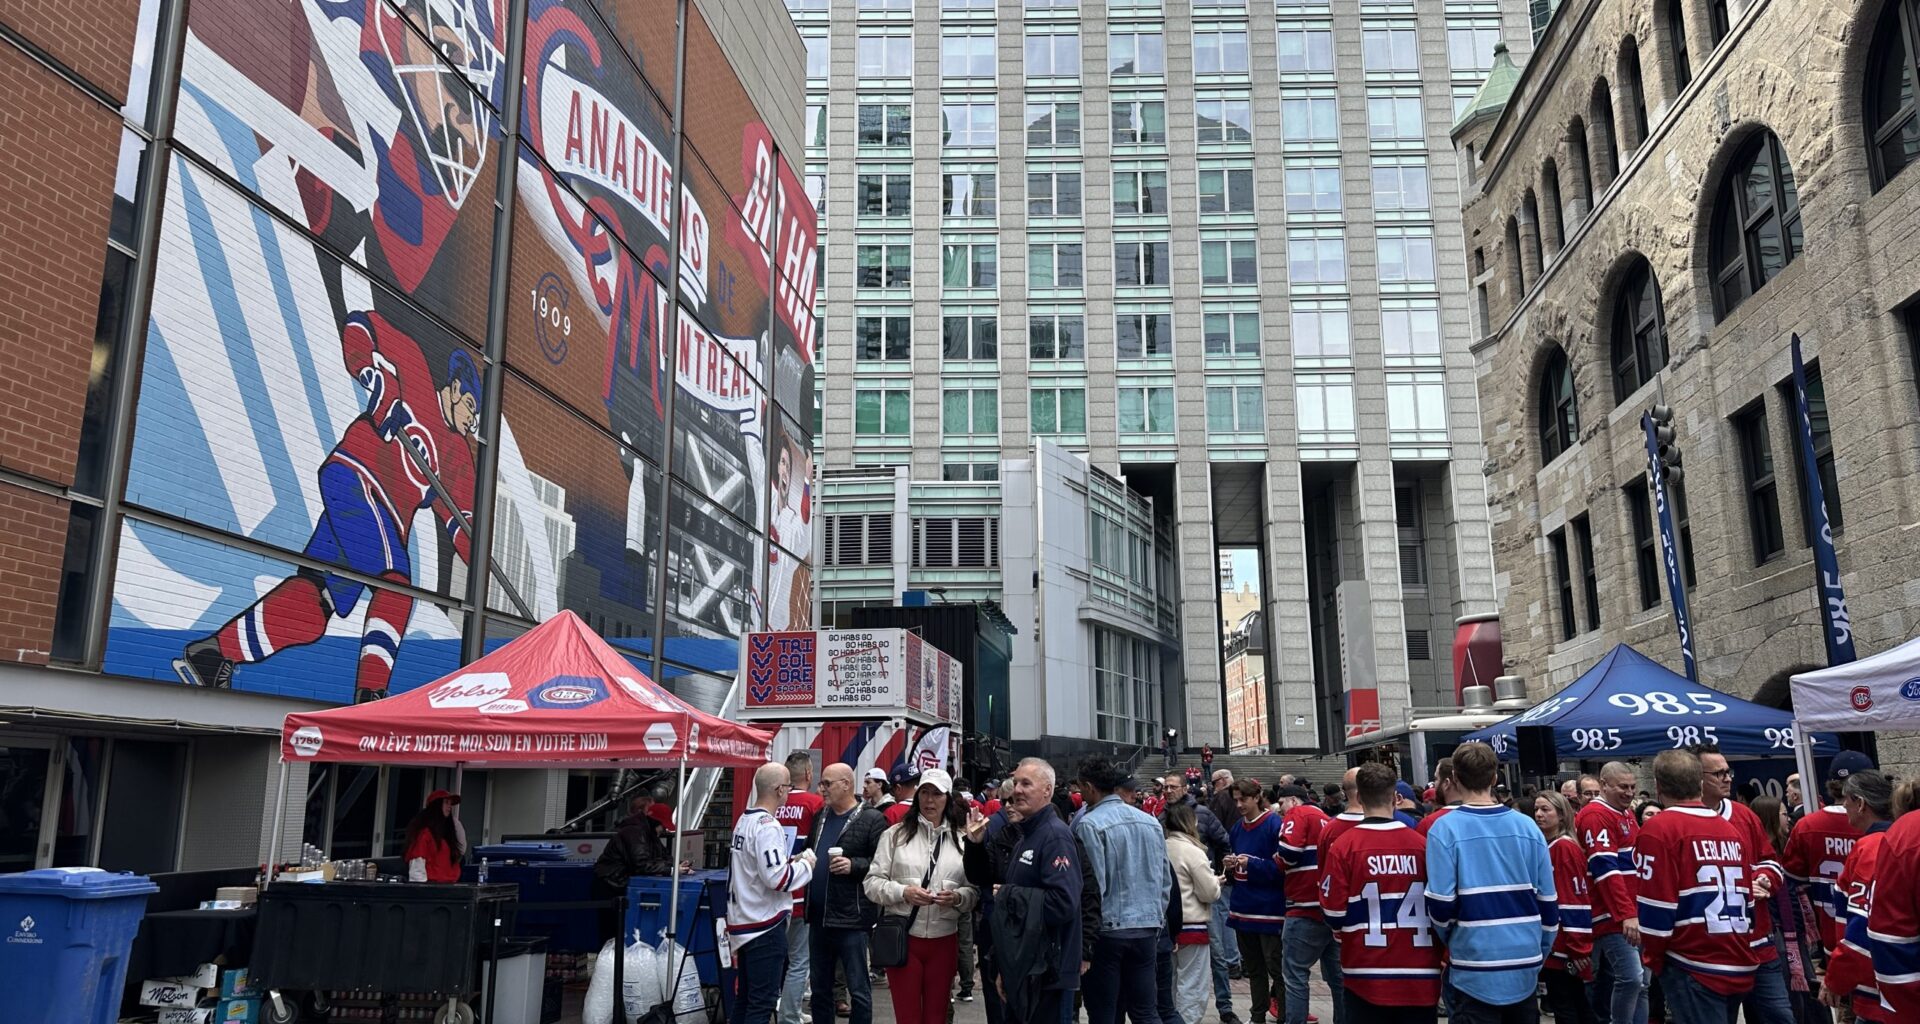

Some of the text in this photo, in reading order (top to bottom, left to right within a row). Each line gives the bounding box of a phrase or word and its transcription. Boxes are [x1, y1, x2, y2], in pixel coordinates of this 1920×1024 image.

[718, 261, 736, 316] DE
[531, 290, 571, 336] 1909
[777, 638, 813, 653] TRI
[778, 653, 812, 669] COL
[778, 668, 813, 683] ORE
[428, 682, 511, 704] Molson
[776, 684, 812, 693] sports
[1907, 681, 1920, 697] Fo
[1608, 691, 1727, 716] 98.5
[294, 736, 321, 745] 1786
[359, 731, 608, 752] ON LÈVE NOTRE MOLSON EN VOTRE NOM
[1571, 728, 1623, 751] 98.5
[1667, 725, 1719, 749] 985
[774, 805, 803, 820] ERSON
[1585, 829, 1610, 848] 44
[1825, 837, 1856, 855] PRIC
[764, 848, 781, 868] 11
[1693, 840, 1742, 861] LEBLANC
[1367, 855, 1417, 875] SUZUKI
[1636, 854, 1655, 880] 25
[1573, 876, 1588, 895] 14
[1697, 865, 1749, 934] 25
[1361, 881, 1433, 947] 14
[148, 986, 189, 1005] Molson
